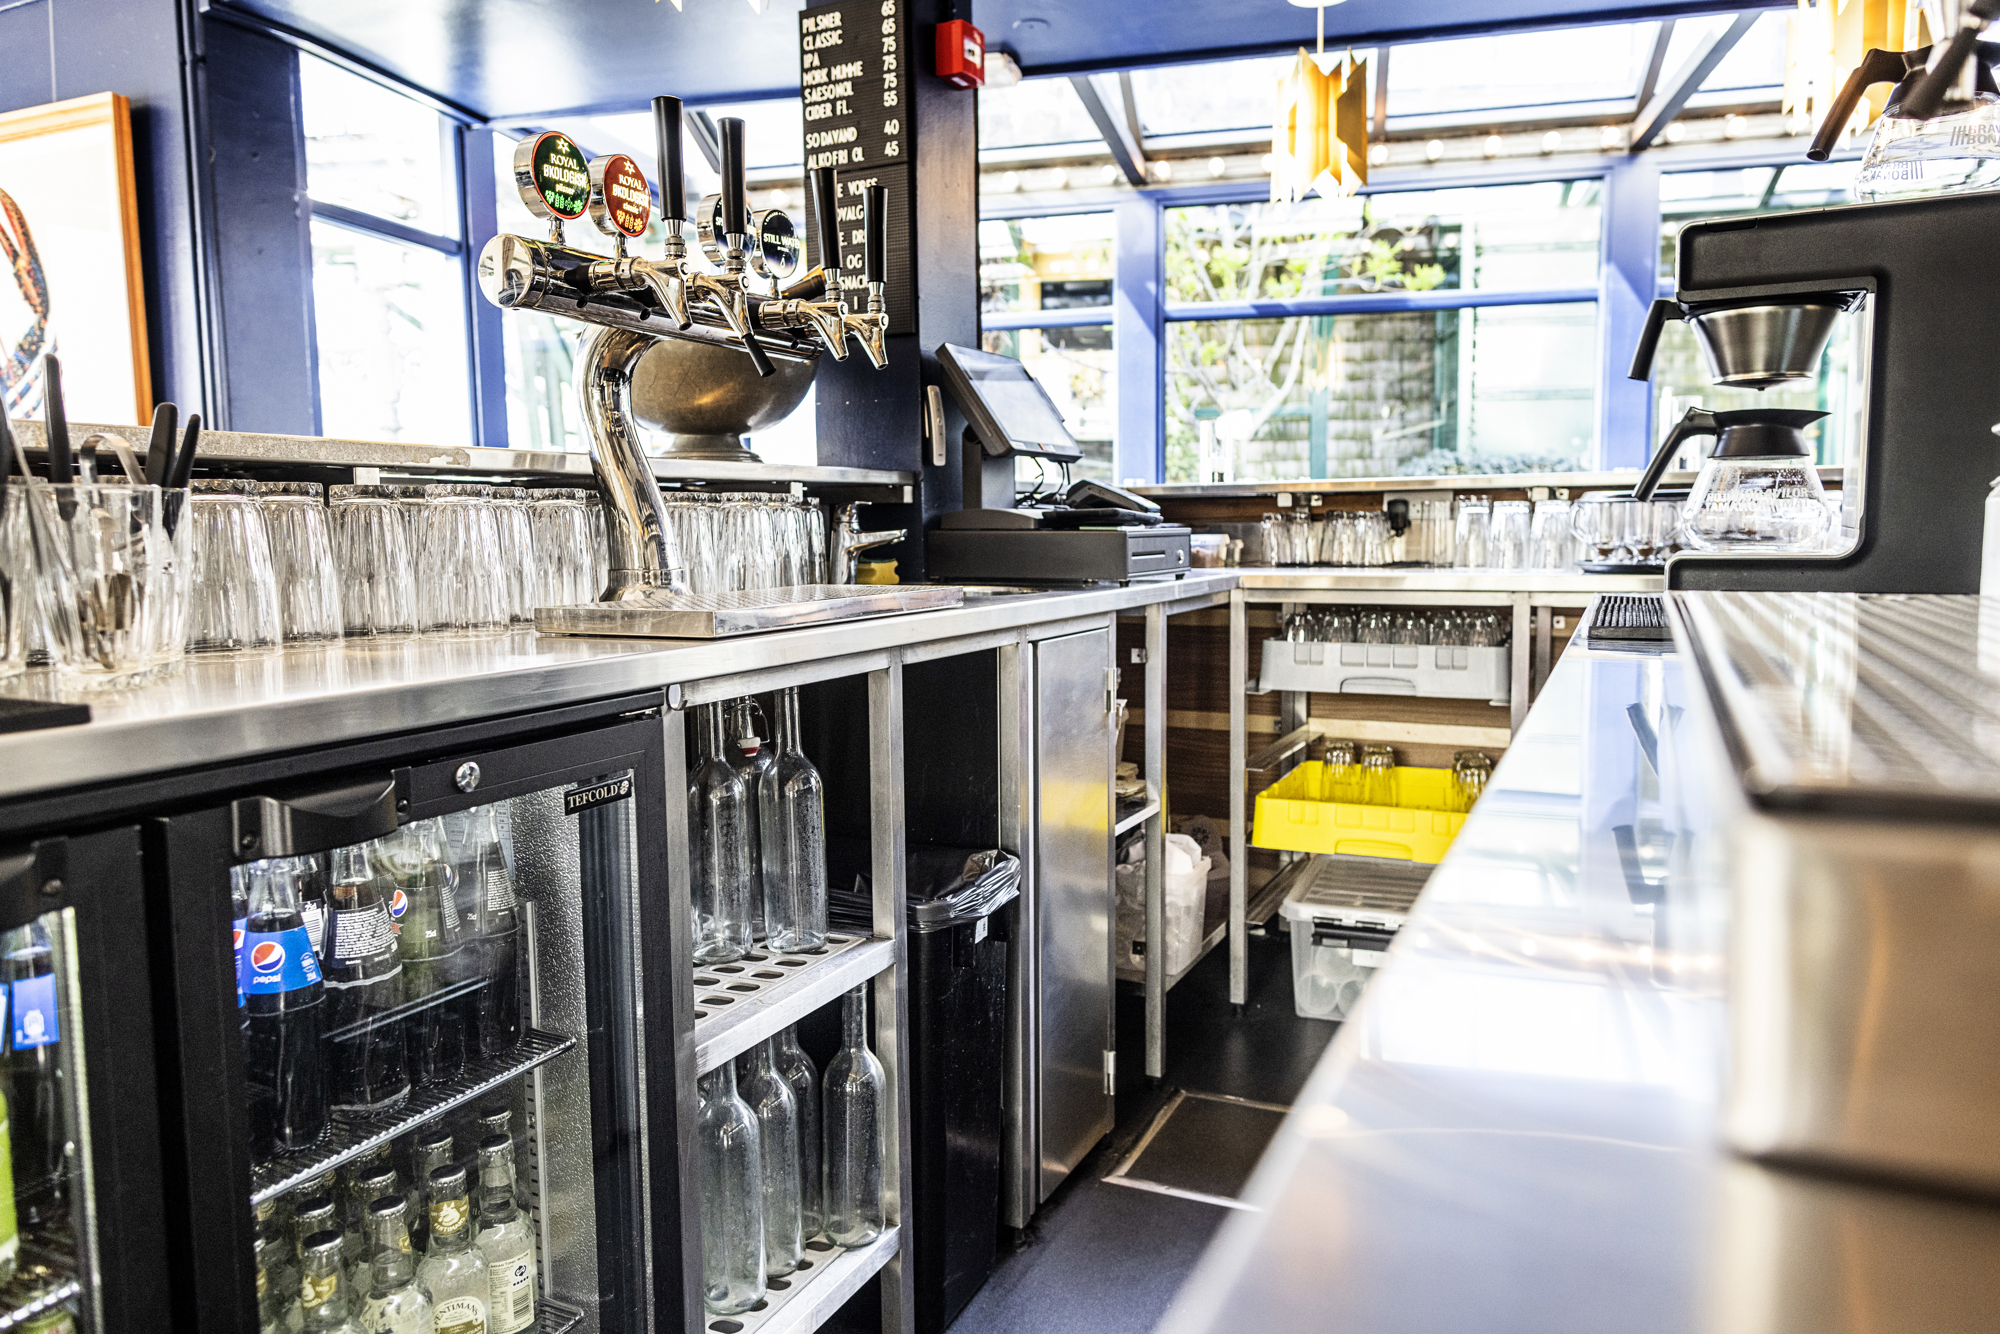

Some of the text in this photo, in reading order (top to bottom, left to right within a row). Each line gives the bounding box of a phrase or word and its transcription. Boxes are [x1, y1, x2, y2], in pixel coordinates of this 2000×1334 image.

[802, 0, 896, 34] PILSNER 65
[803, 17, 896, 51] CLASSIC 65
[803, 35, 897, 69] IPA 75
[882, 54, 897, 71] 75
[882, 72, 898, 90] 75
[805, 90, 898, 121] CIDER FL. 55
[806, 119, 900, 149] SODAVAND 40
[550, 152, 580, 171] ROYAL
[807, 149, 848, 171] ALKOFRI
[884, 141, 900, 157] 45
[543, 163, 588, 189] ØKOLOGISK
[618, 173, 644, 191] ROYAL
[763, 233, 782, 246] STILL
[846, 254, 863, 270] OG
[567, 784, 619, 809] TEFCOLD
[253, 973, 282, 985] pepsi
